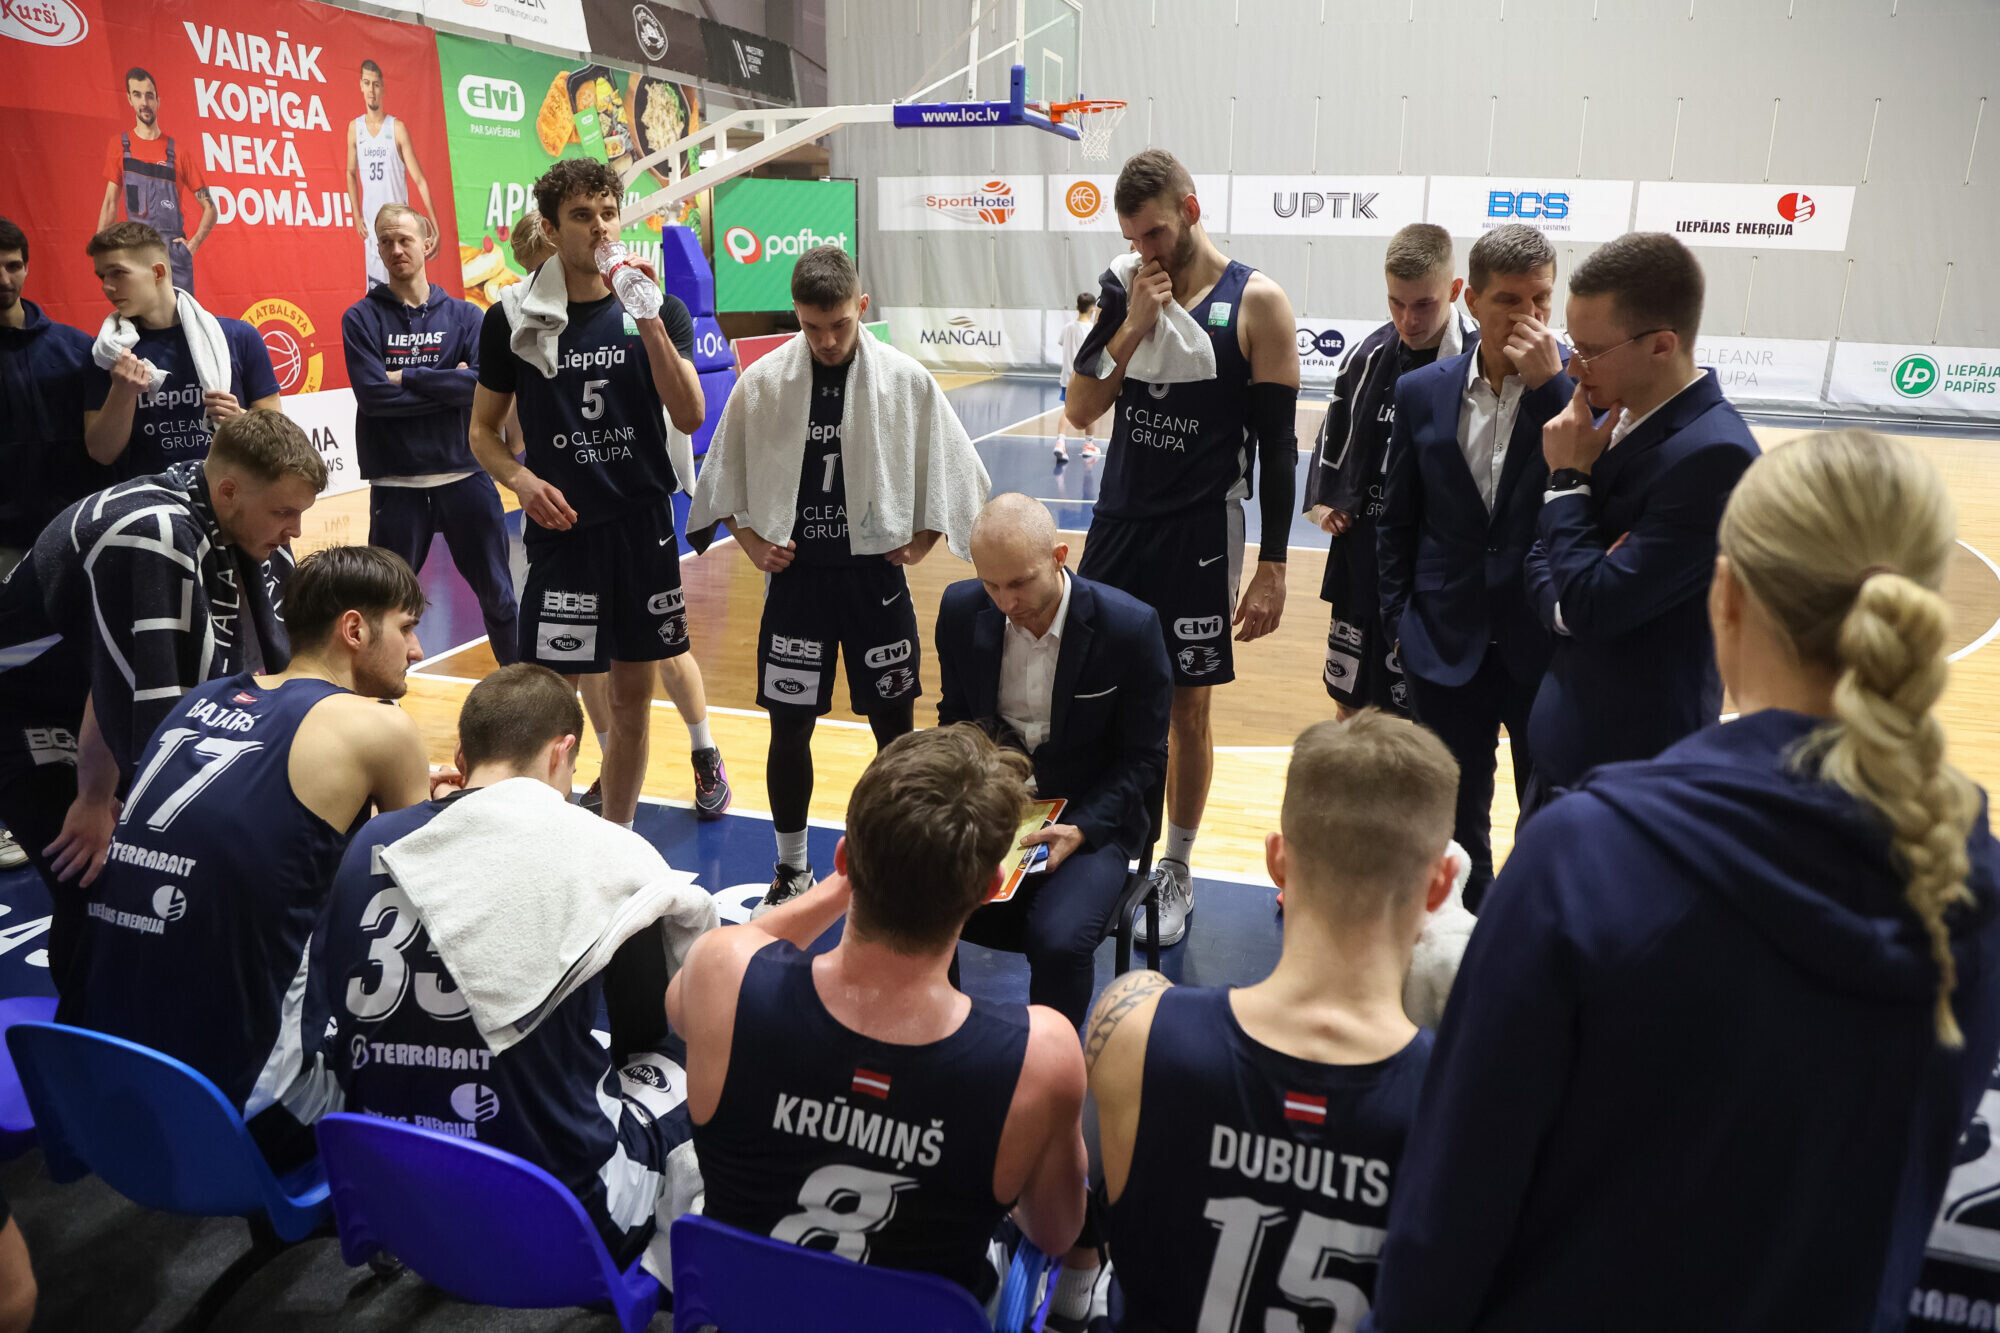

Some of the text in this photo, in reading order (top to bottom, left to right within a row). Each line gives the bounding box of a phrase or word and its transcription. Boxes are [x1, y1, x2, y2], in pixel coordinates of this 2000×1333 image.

[183, 20, 328, 84] VAIRĀK
[194, 78, 332, 133] KOPĪGA
[922, 108, 1000, 124] www.loc.lv
[470, 123, 484, 136] PAR
[201, 132, 306, 178] NEKĀ
[369, 161, 385, 181] 35
[208, 181, 354, 228] DOMĀJI!
[926, 195, 1015, 210] SportHotel
[1273, 191, 1380, 219] UPTK
[1487, 191, 1570, 219] BCS
[1675, 219, 1794, 239] LIEPĀJAS ENERĢIJA
[255, 304, 308, 333] ATBALSTA
[387, 331, 448, 347] LIEPJAS
[1319, 339, 1342, 348] LSEZ
[1299, 357, 1335, 367] IEPĀJA
[1694, 347, 1774, 366] CLEANR
[1719, 369, 1759, 387] UPA
[1944, 379, 1997, 394] PAPĪRS
[138, 383, 206, 410] Lepāj
[581, 379, 610, 421] 5
[159, 419, 203, 434] CLEA
[1134, 409, 1199, 435] CLEANR
[161, 434, 214, 449] GRUPA
[571, 426, 636, 446] CLEANR
[1131, 428, 1185, 453] GRUPA
[574, 446, 633, 464] GRUPA
[822, 453, 841, 493] 1
[803, 505, 848, 521] CLEA
[803, 524, 850, 539] GRUP
[542, 590, 598, 614] BCS
[771, 633, 823, 660] BCS
[185, 698, 263, 732] BAJĀRS
[118, 727, 265, 832] 17
[111, 842, 197, 877] TERRABALT
[370, 1042, 494, 1071] TERRABALT
[771, 1093, 946, 1171] KRŪMIŅŠ
[1209, 1123, 1391, 1208] DUBULTS
[769, 1163, 921, 1265] 8
[1196, 1196, 1389, 1333] 15
